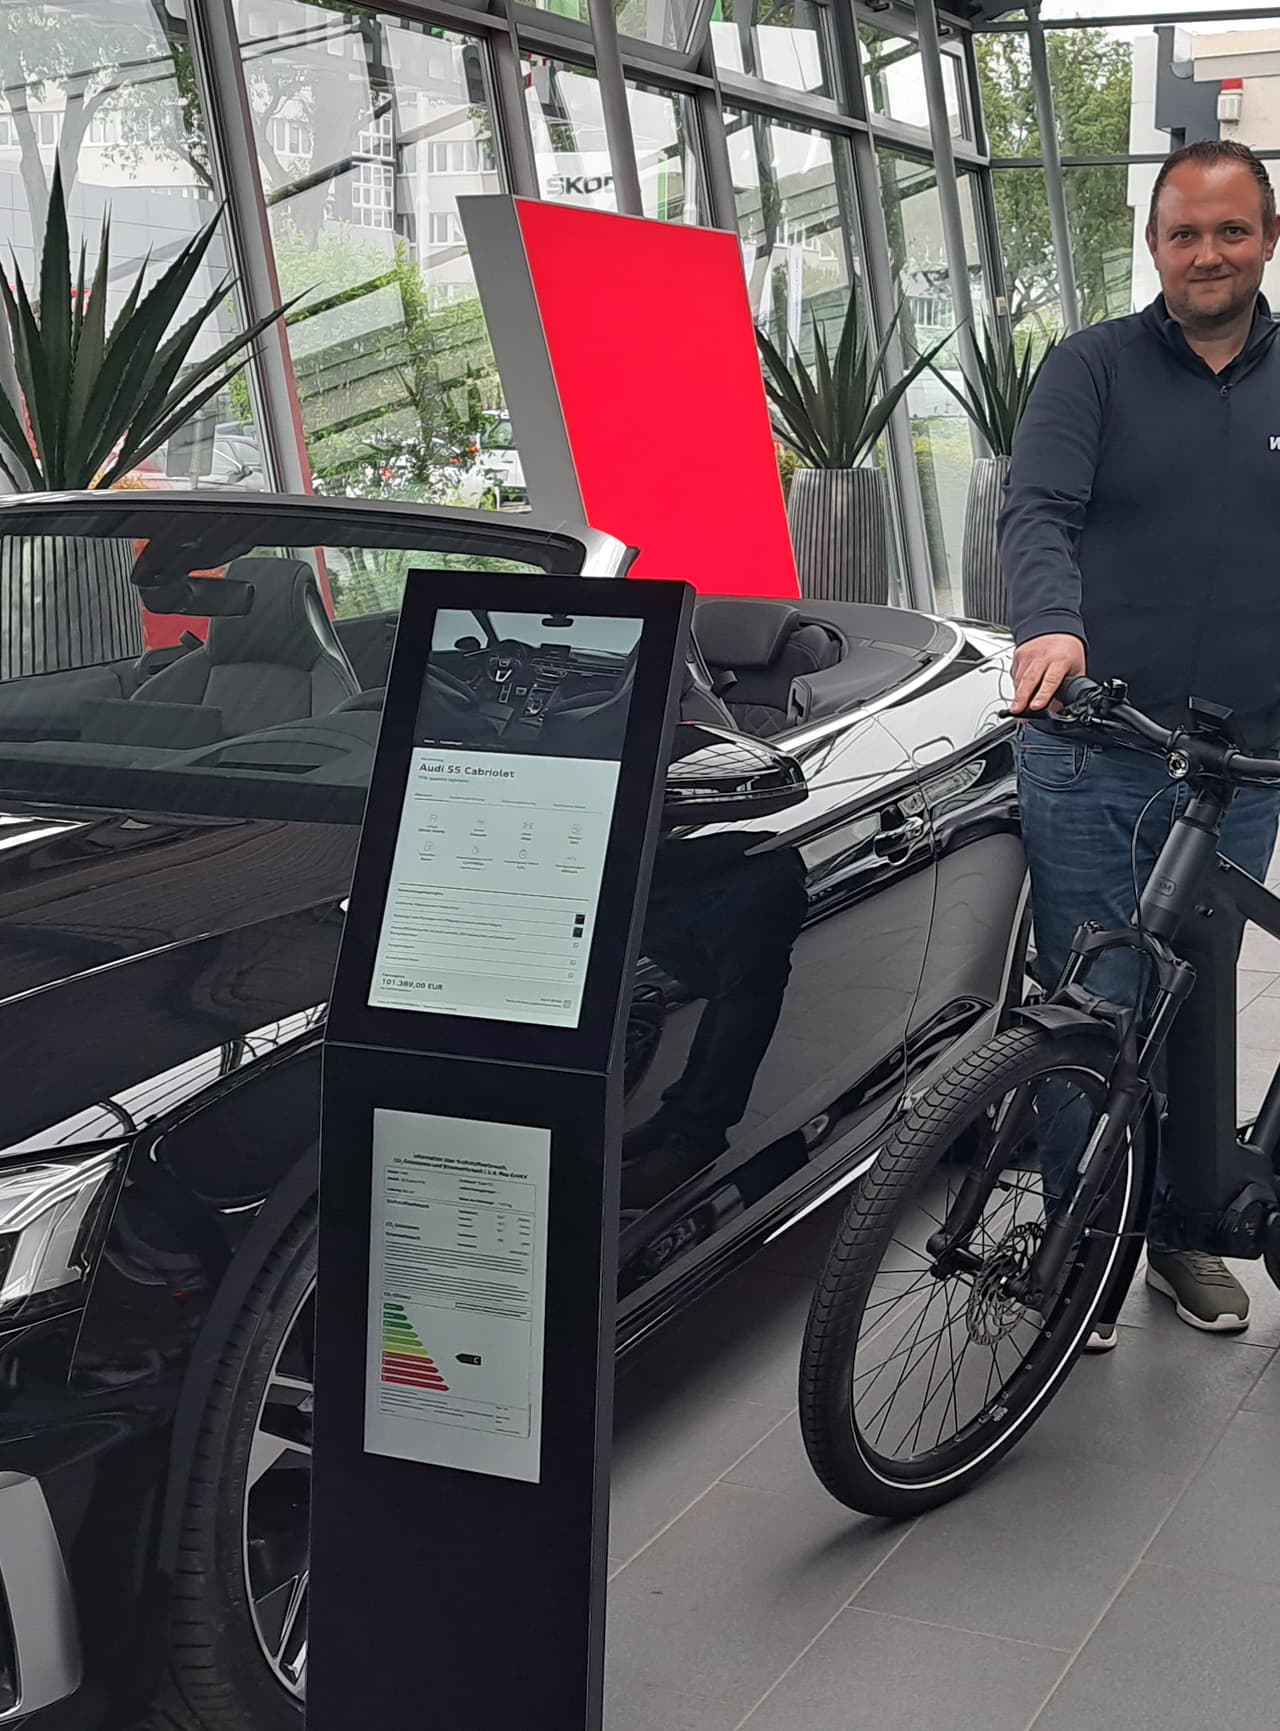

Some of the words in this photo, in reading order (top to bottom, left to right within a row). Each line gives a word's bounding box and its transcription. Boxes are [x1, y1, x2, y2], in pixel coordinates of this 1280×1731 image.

[419, 763, 445, 773] Audi
[447, 765, 461, 774] S5
[464, 766, 516, 778] Cabriolet
[427, 983, 443, 991] EUR
